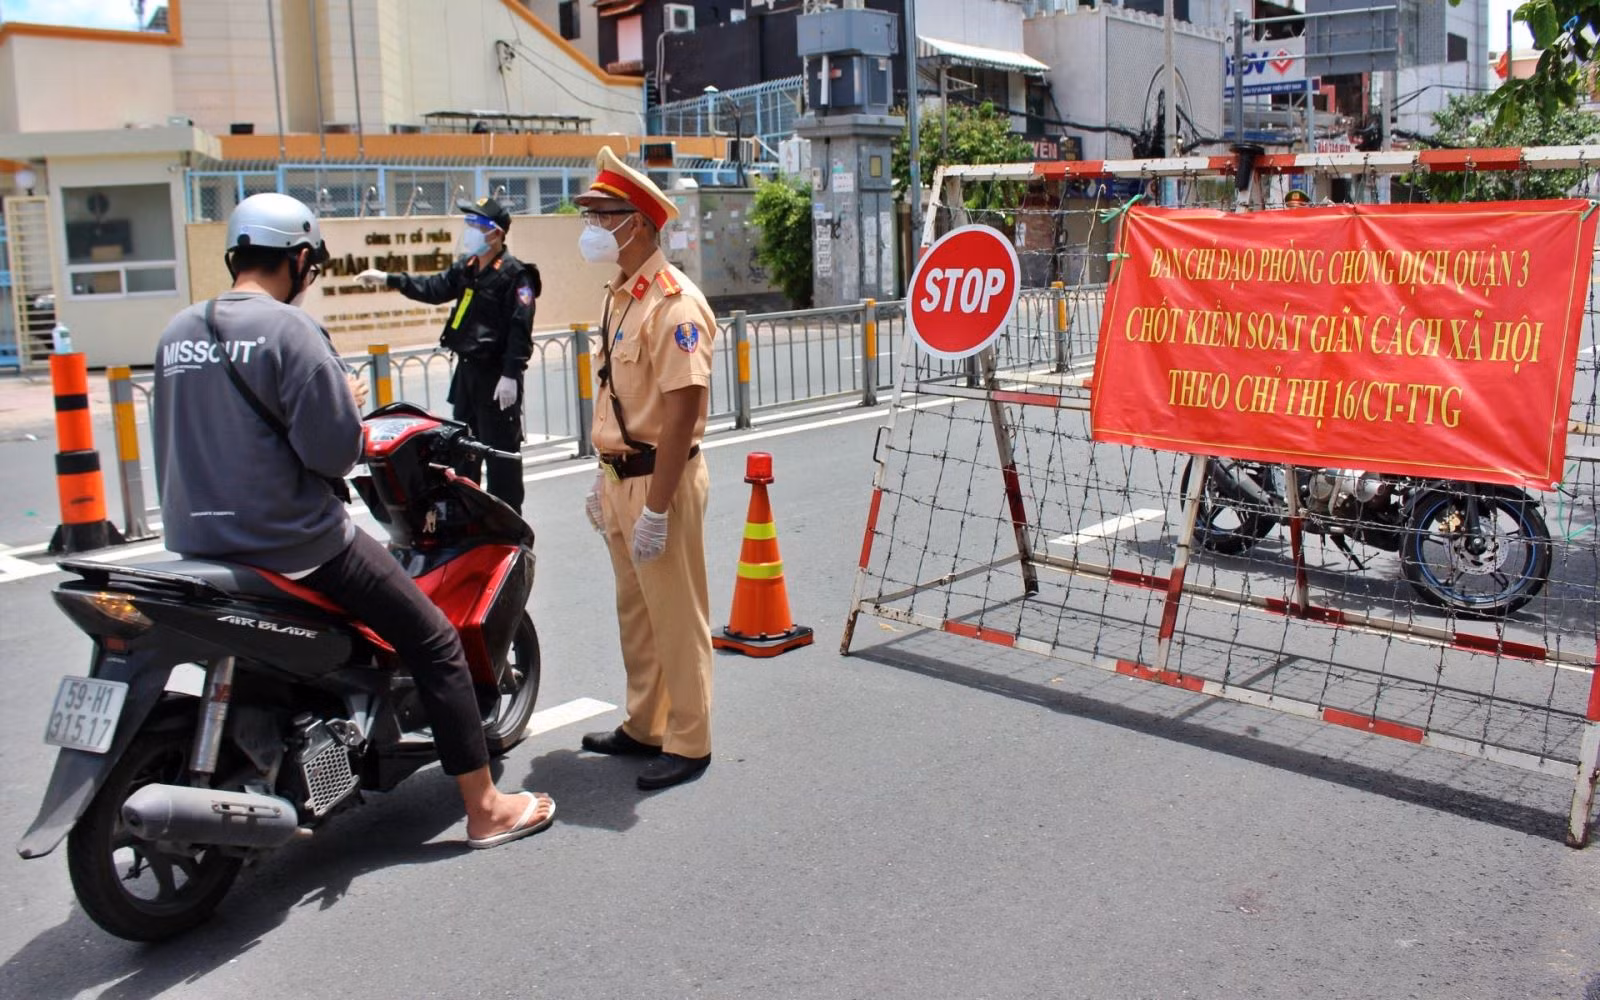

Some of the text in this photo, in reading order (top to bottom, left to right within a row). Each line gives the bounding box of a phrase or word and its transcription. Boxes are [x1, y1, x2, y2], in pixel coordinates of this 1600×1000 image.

[395, 233, 406, 245] TY
[920, 267, 1006, 314] STOP
[1149, 239, 1530, 297] BAN CHỈ ĐẠO PHÒNG CHỐNG DỊCH QUẬN 3
[1125, 296, 1545, 374] CHỐT KIỂM SOÁT GIÃN CÁCH XÃ HỘI
[1168, 365, 1464, 429] THEO CHỈ THỊ 16/CT-TTG
[217, 615, 318, 639] AIR BLADE
